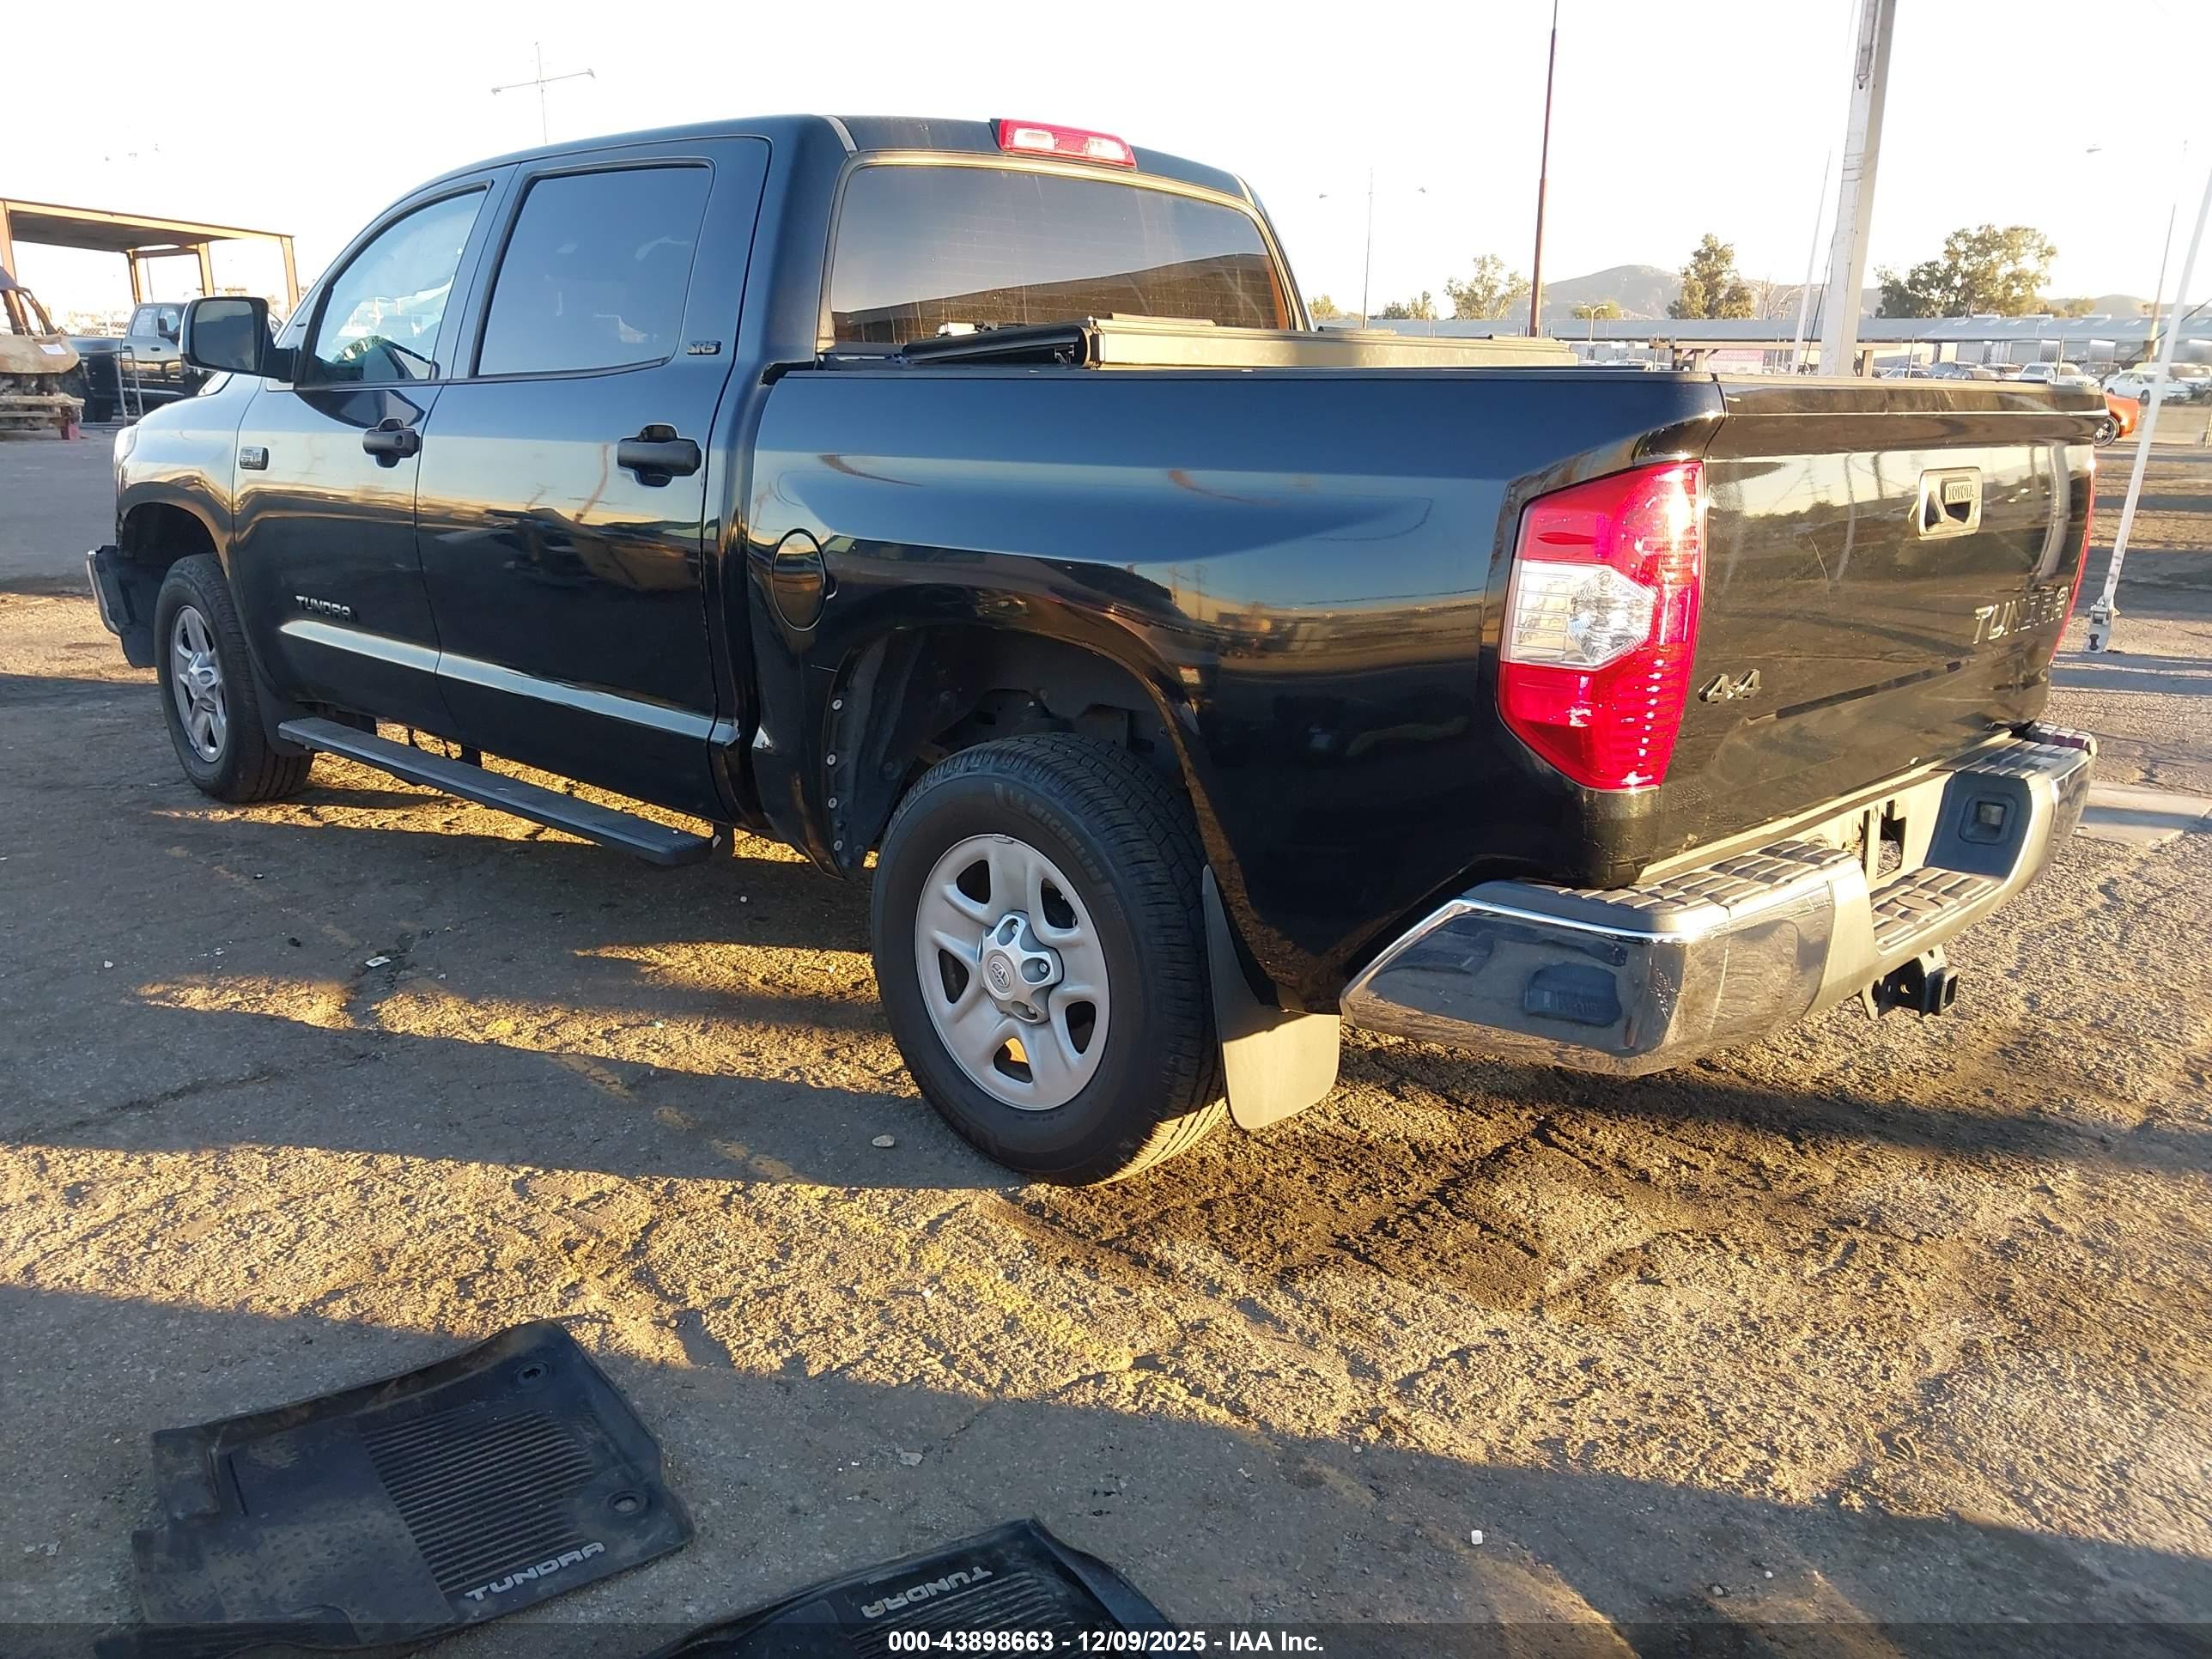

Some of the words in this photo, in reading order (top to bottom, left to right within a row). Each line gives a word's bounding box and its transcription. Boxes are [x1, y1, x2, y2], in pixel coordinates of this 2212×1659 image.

[1948, 484, 1974, 501] TOYOTA
[295, 595, 355, 620] TUNDRA
[1973, 586, 2070, 644] TUNDRA
[465, 1542, 605, 1601] TUNDRA
[860, 1566, 994, 1619] TUNDRA
